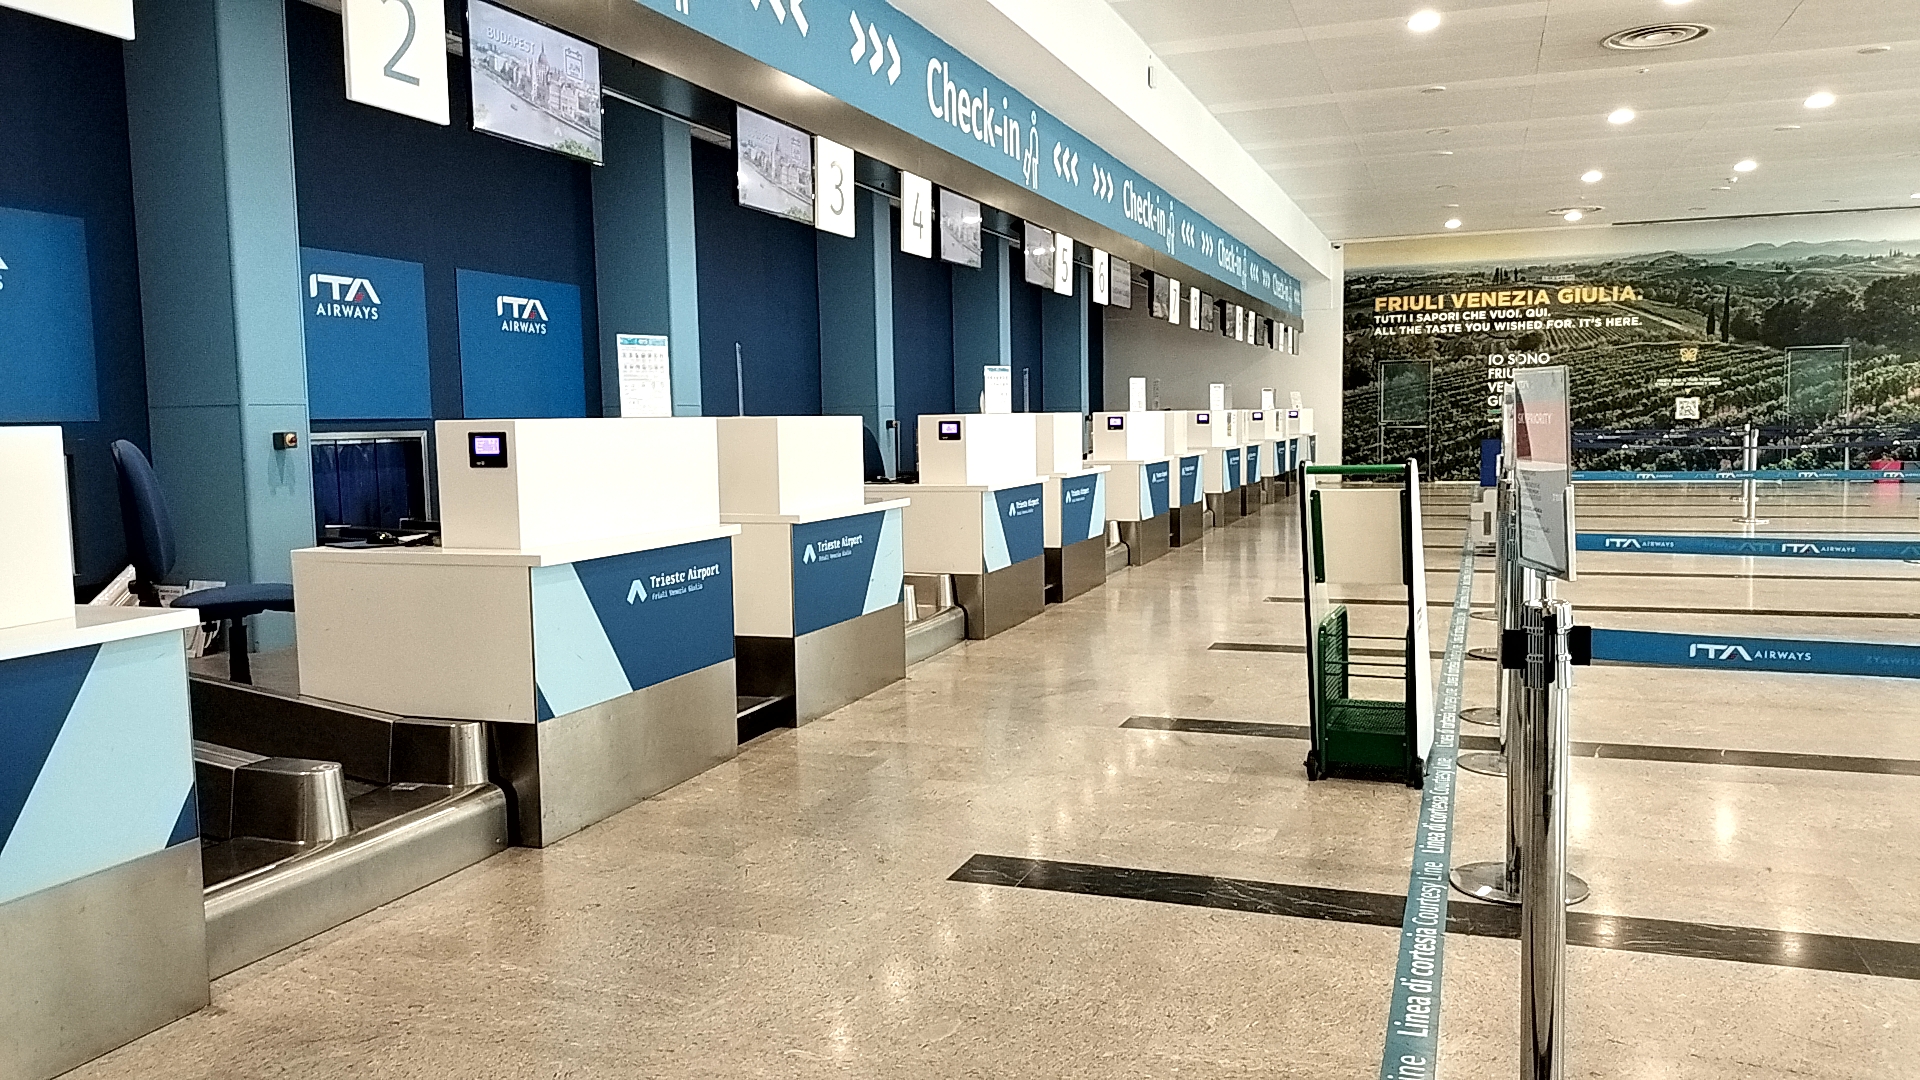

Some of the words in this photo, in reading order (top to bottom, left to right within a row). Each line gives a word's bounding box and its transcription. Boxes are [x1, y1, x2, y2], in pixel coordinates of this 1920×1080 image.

[382, 0, 420, 87] 2
[486, 27, 535, 55] BUDAPEST
[926, 57, 1021, 161] Check-in
[830, 160, 845, 216] 3
[912, 191, 924, 240] 4
[1123, 179, 1166, 238] Check-in
[1061, 247, 1069, 283] 5
[1217, 237, 1242, 277] Check-in
[309, 273, 382, 305] ITA
[1098, 261, 1105, 294] 6
[316, 302, 379, 320] AIRWAYS
[496, 295, 549, 322] ITA
[1374, 294, 1444, 312] FRIULI
[1450, 289, 1550, 309] VENEZIA
[1557, 285, 1644, 304] GIULIA.
[501, 319, 547, 335] AIRWAYS
[1374, 314, 1407, 325] TUTTI
[1410, 314, 1414, 323] I
[1416, 312, 1459, 323] SAPORI
[1462, 311, 1487, 321] CHE
[1525, 307, 1552, 319] QUI.
[1374, 325, 1397, 336] ALL
[1399, 325, 1422, 336] THE
[1424, 323, 1462, 335] TASTE
[1464, 322, 1490, 333] YOU
[1493, 320, 1543, 332] WISHED
[1546, 318, 1576, 330] FOR.
[1578, 317, 1602, 329] IT'S
[1605, 315, 1643, 327] HERE.
[1488, 353, 1504, 366] IO
[1507, 352, 1551, 365] SONO
[1487, 367, 1515, 380] FRIU
[817, 539, 841, 552] Trieste
[841, 534, 863, 548] Airport
[1605, 537, 1642, 549] ITA
[1642, 541, 1675, 549] AIRWAYS
[1781, 543, 1820, 554] ITA
[1820, 545, 1856, 553] AIRWAYS
[650, 572, 686, 588] Trieste
[687, 563, 720, 581] Airport
[1689, 643, 1753, 661] ITA
[1754, 649, 1812, 662] AIRWAYS
[1431, 757, 1452, 772] Line
[1429, 770, 1455, 795] Courtesy
[1426, 795, 1449, 822] cortesia
[1422, 822, 1447, 831] di
[1419, 831, 1445, 854] Linea
[1416, 861, 1444, 882] Line
[1412, 882, 1447, 926] Courtesy
[1406, 927, 1438, 977] cortesia
[1400, 977, 1433, 994] di
[1394, 995, 1433, 1038] Linea
[1387, 1055, 1426, 1080] ine
